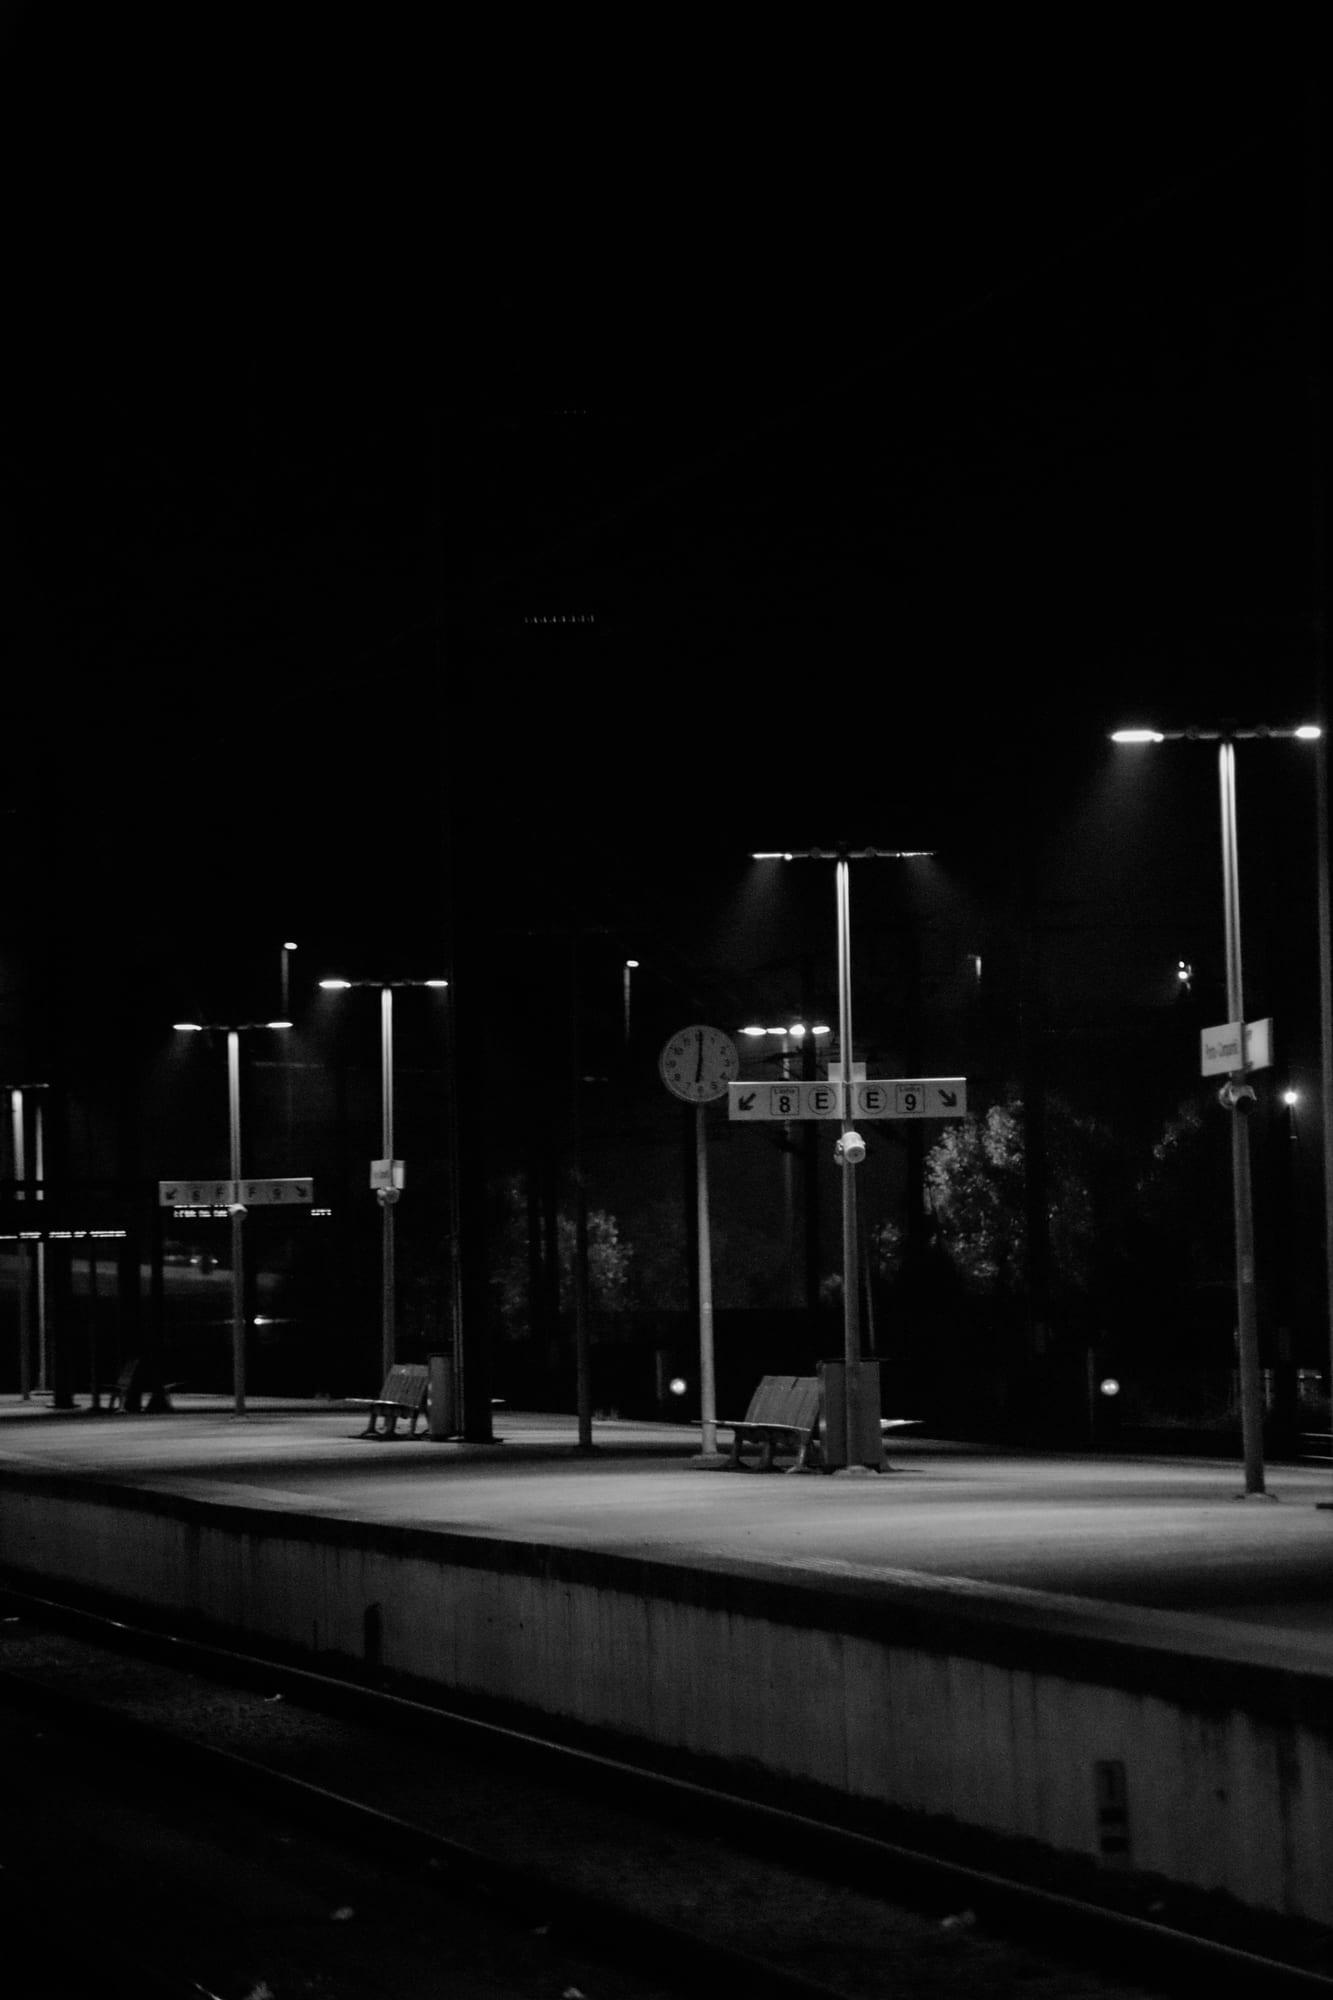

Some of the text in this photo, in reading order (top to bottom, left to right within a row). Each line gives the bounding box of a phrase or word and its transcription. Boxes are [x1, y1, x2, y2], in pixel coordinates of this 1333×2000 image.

[779, 1095, 791, 1113] 8
[815, 1092, 829, 1109] E
[867, 1091, 880, 1109] E
[904, 1093, 917, 1111] 9
